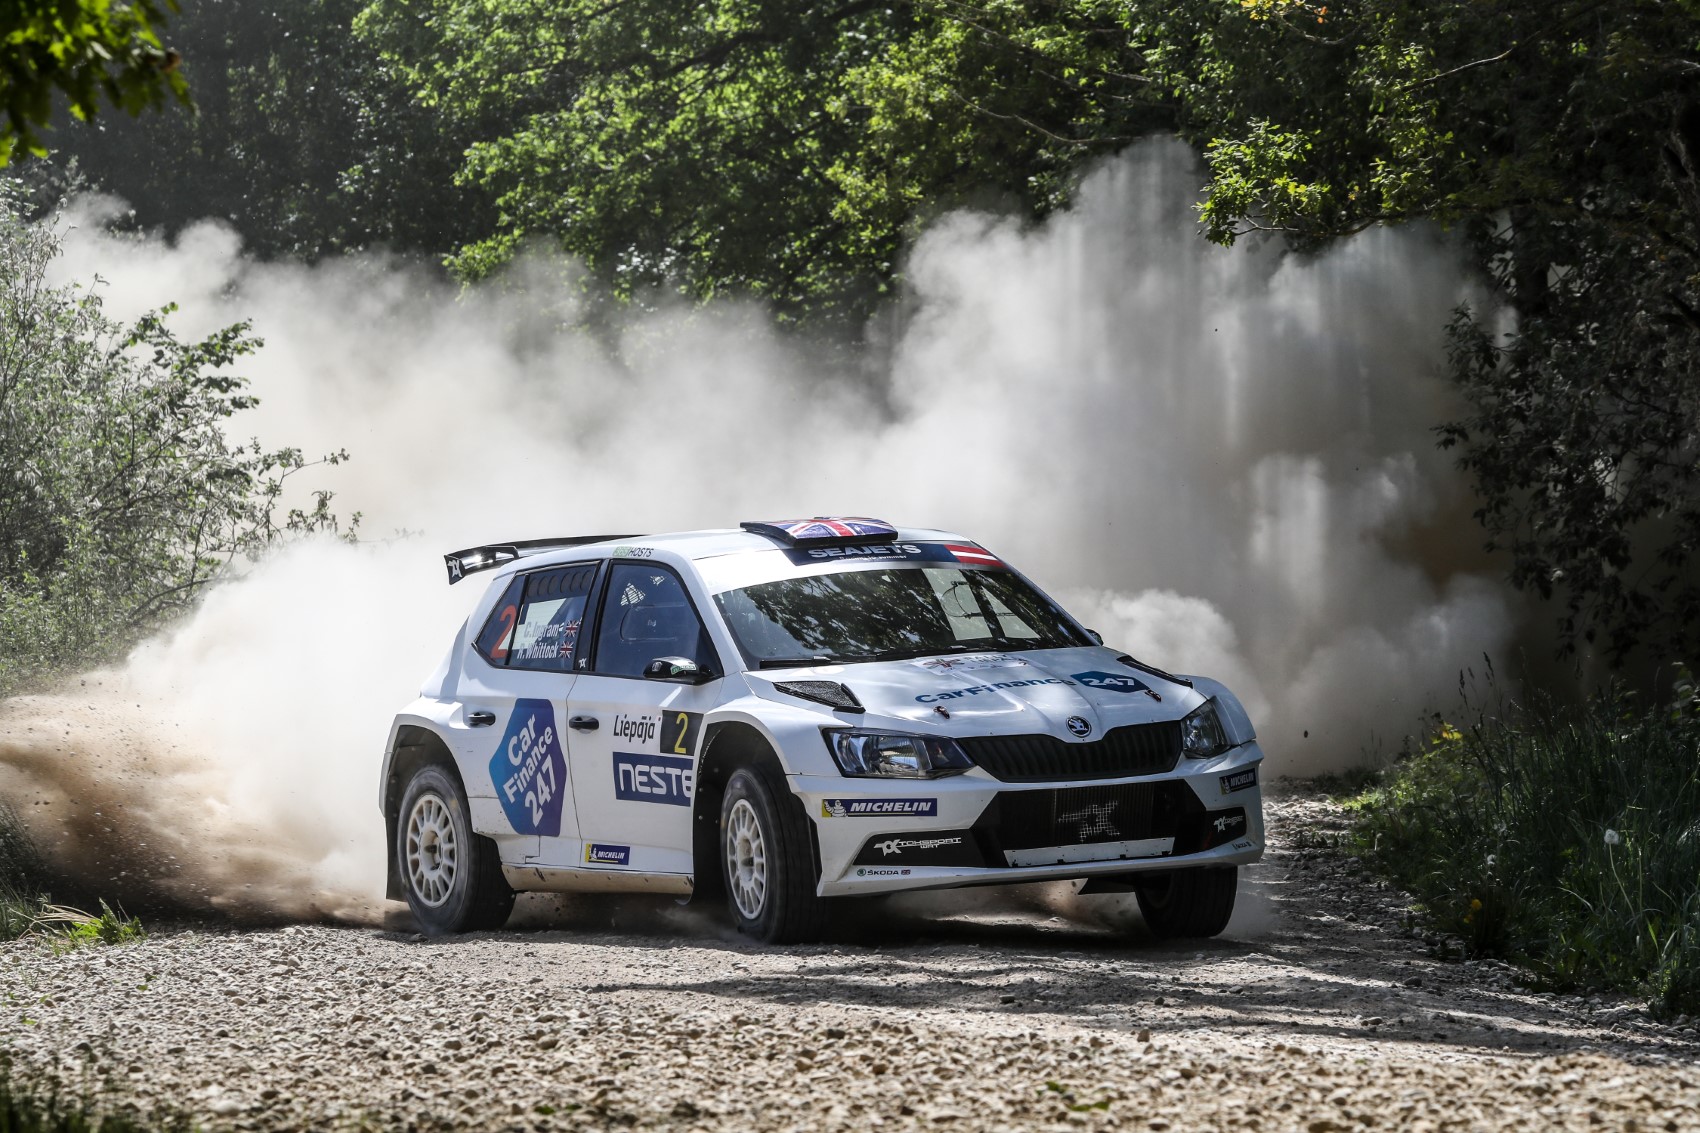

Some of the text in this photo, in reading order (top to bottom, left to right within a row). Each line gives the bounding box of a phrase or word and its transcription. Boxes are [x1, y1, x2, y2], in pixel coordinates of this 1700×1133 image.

[807, 544, 922, 558] SEAJETS
[490, 604, 517, 659] 2
[1082, 678, 1135, 689] 247
[507, 713, 536, 767] Car
[674, 712, 689, 754] 2
[502, 726, 553, 804] Finance
[618, 762, 693, 798] NESTE
[524, 754, 556, 828] 247
[850, 801, 932, 812] MICHELIN
[597, 850, 626, 860] MICHELIN
